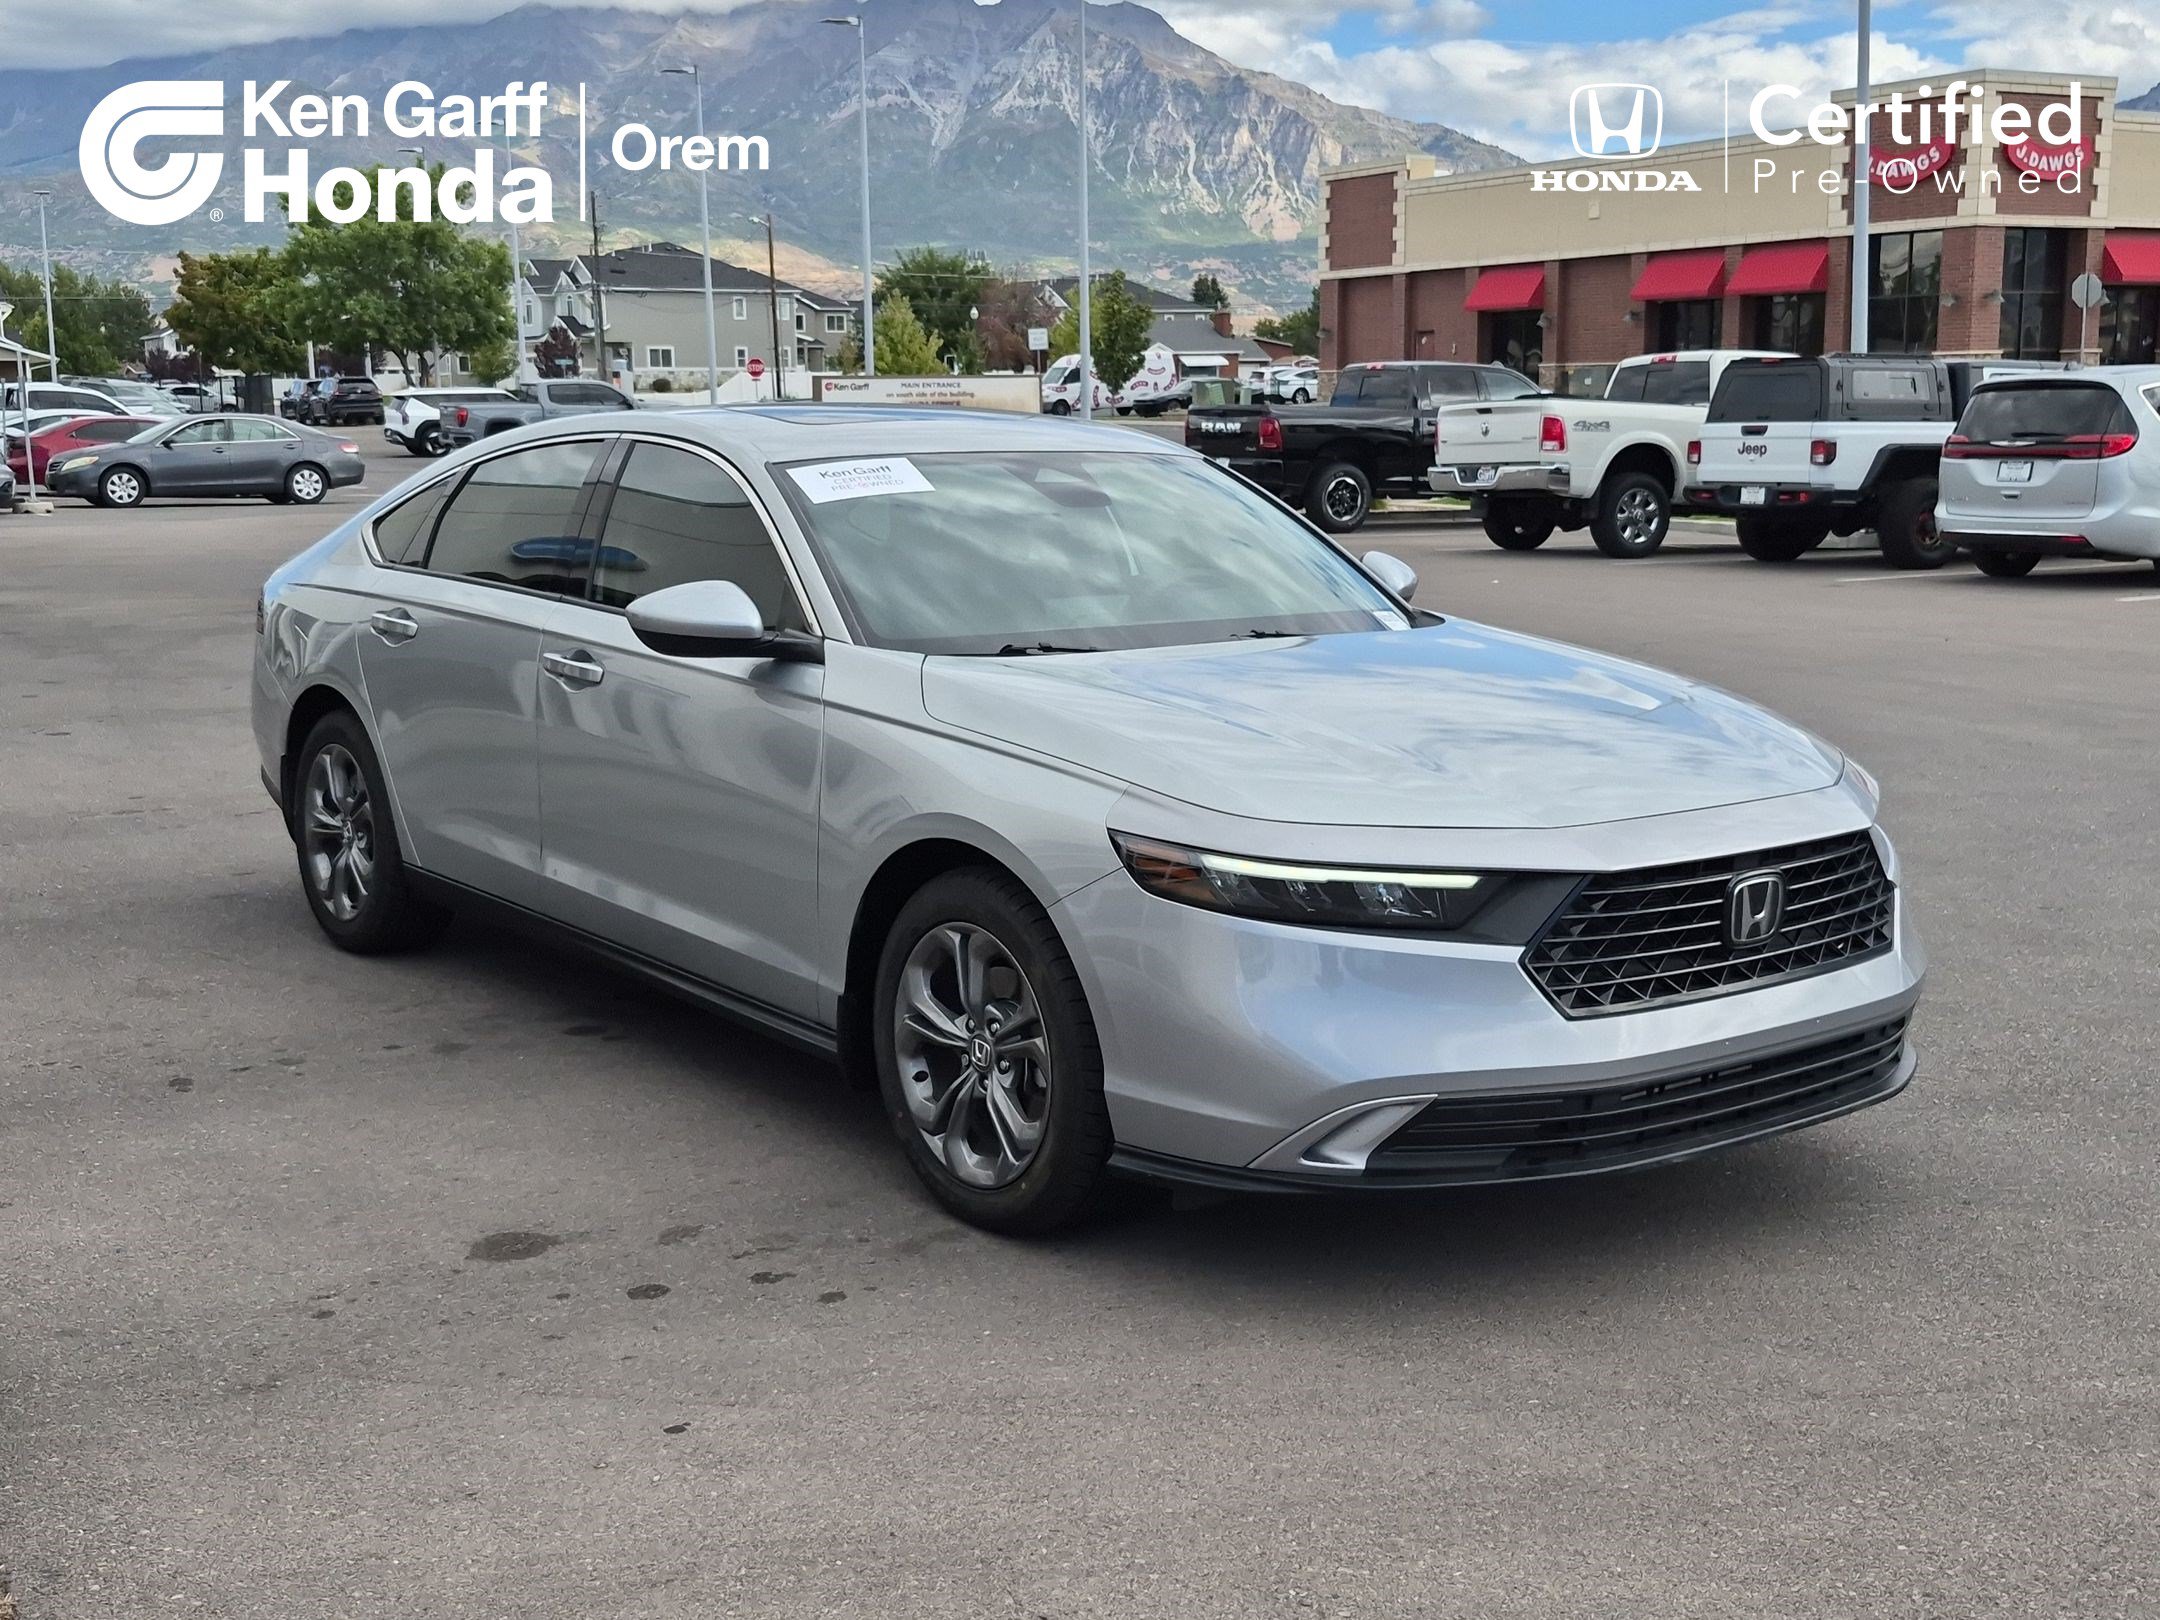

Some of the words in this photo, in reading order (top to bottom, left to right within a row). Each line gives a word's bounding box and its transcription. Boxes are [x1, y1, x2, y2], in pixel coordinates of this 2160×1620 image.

[2015, 144, 2085, 172] J.DAWGS
[747, 363, 764, 372] STOP
[834, 382, 848, 391] Ken
[850, 382, 870, 391] Garff
[1201, 421, 1241, 433] RAM
[1737, 441, 1768, 458] Jeep
[819, 470, 853, 479] Ken
[853, 465, 892, 475] Garff
[833, 473, 892, 485] CERTIFIED
